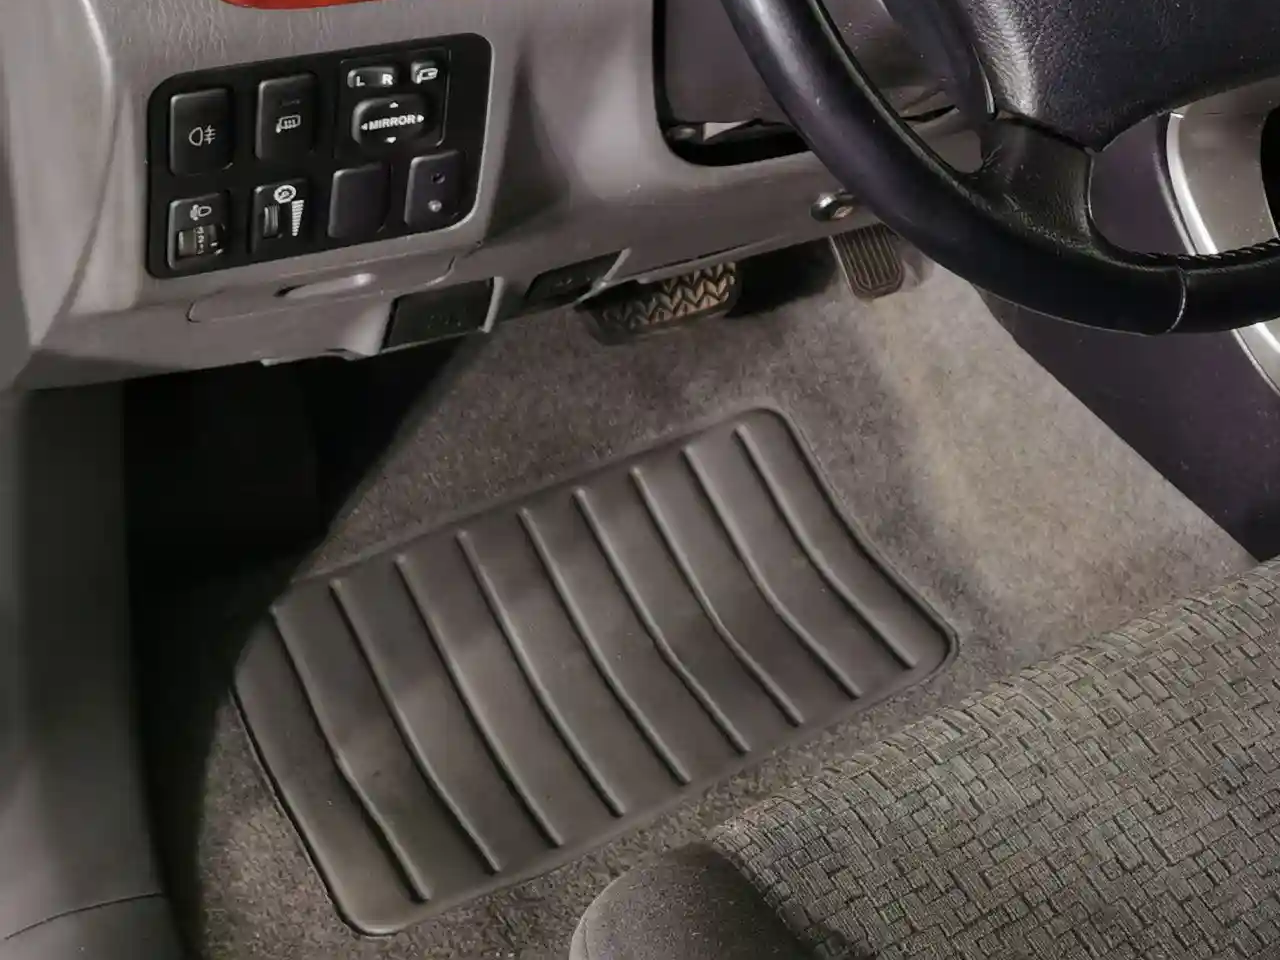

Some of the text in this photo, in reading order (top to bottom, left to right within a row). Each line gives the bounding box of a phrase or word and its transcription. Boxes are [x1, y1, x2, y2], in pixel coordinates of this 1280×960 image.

[356, 75, 366, 87] L
[382, 73, 393, 86] R
[368, 114, 416, 131] MIRROR
